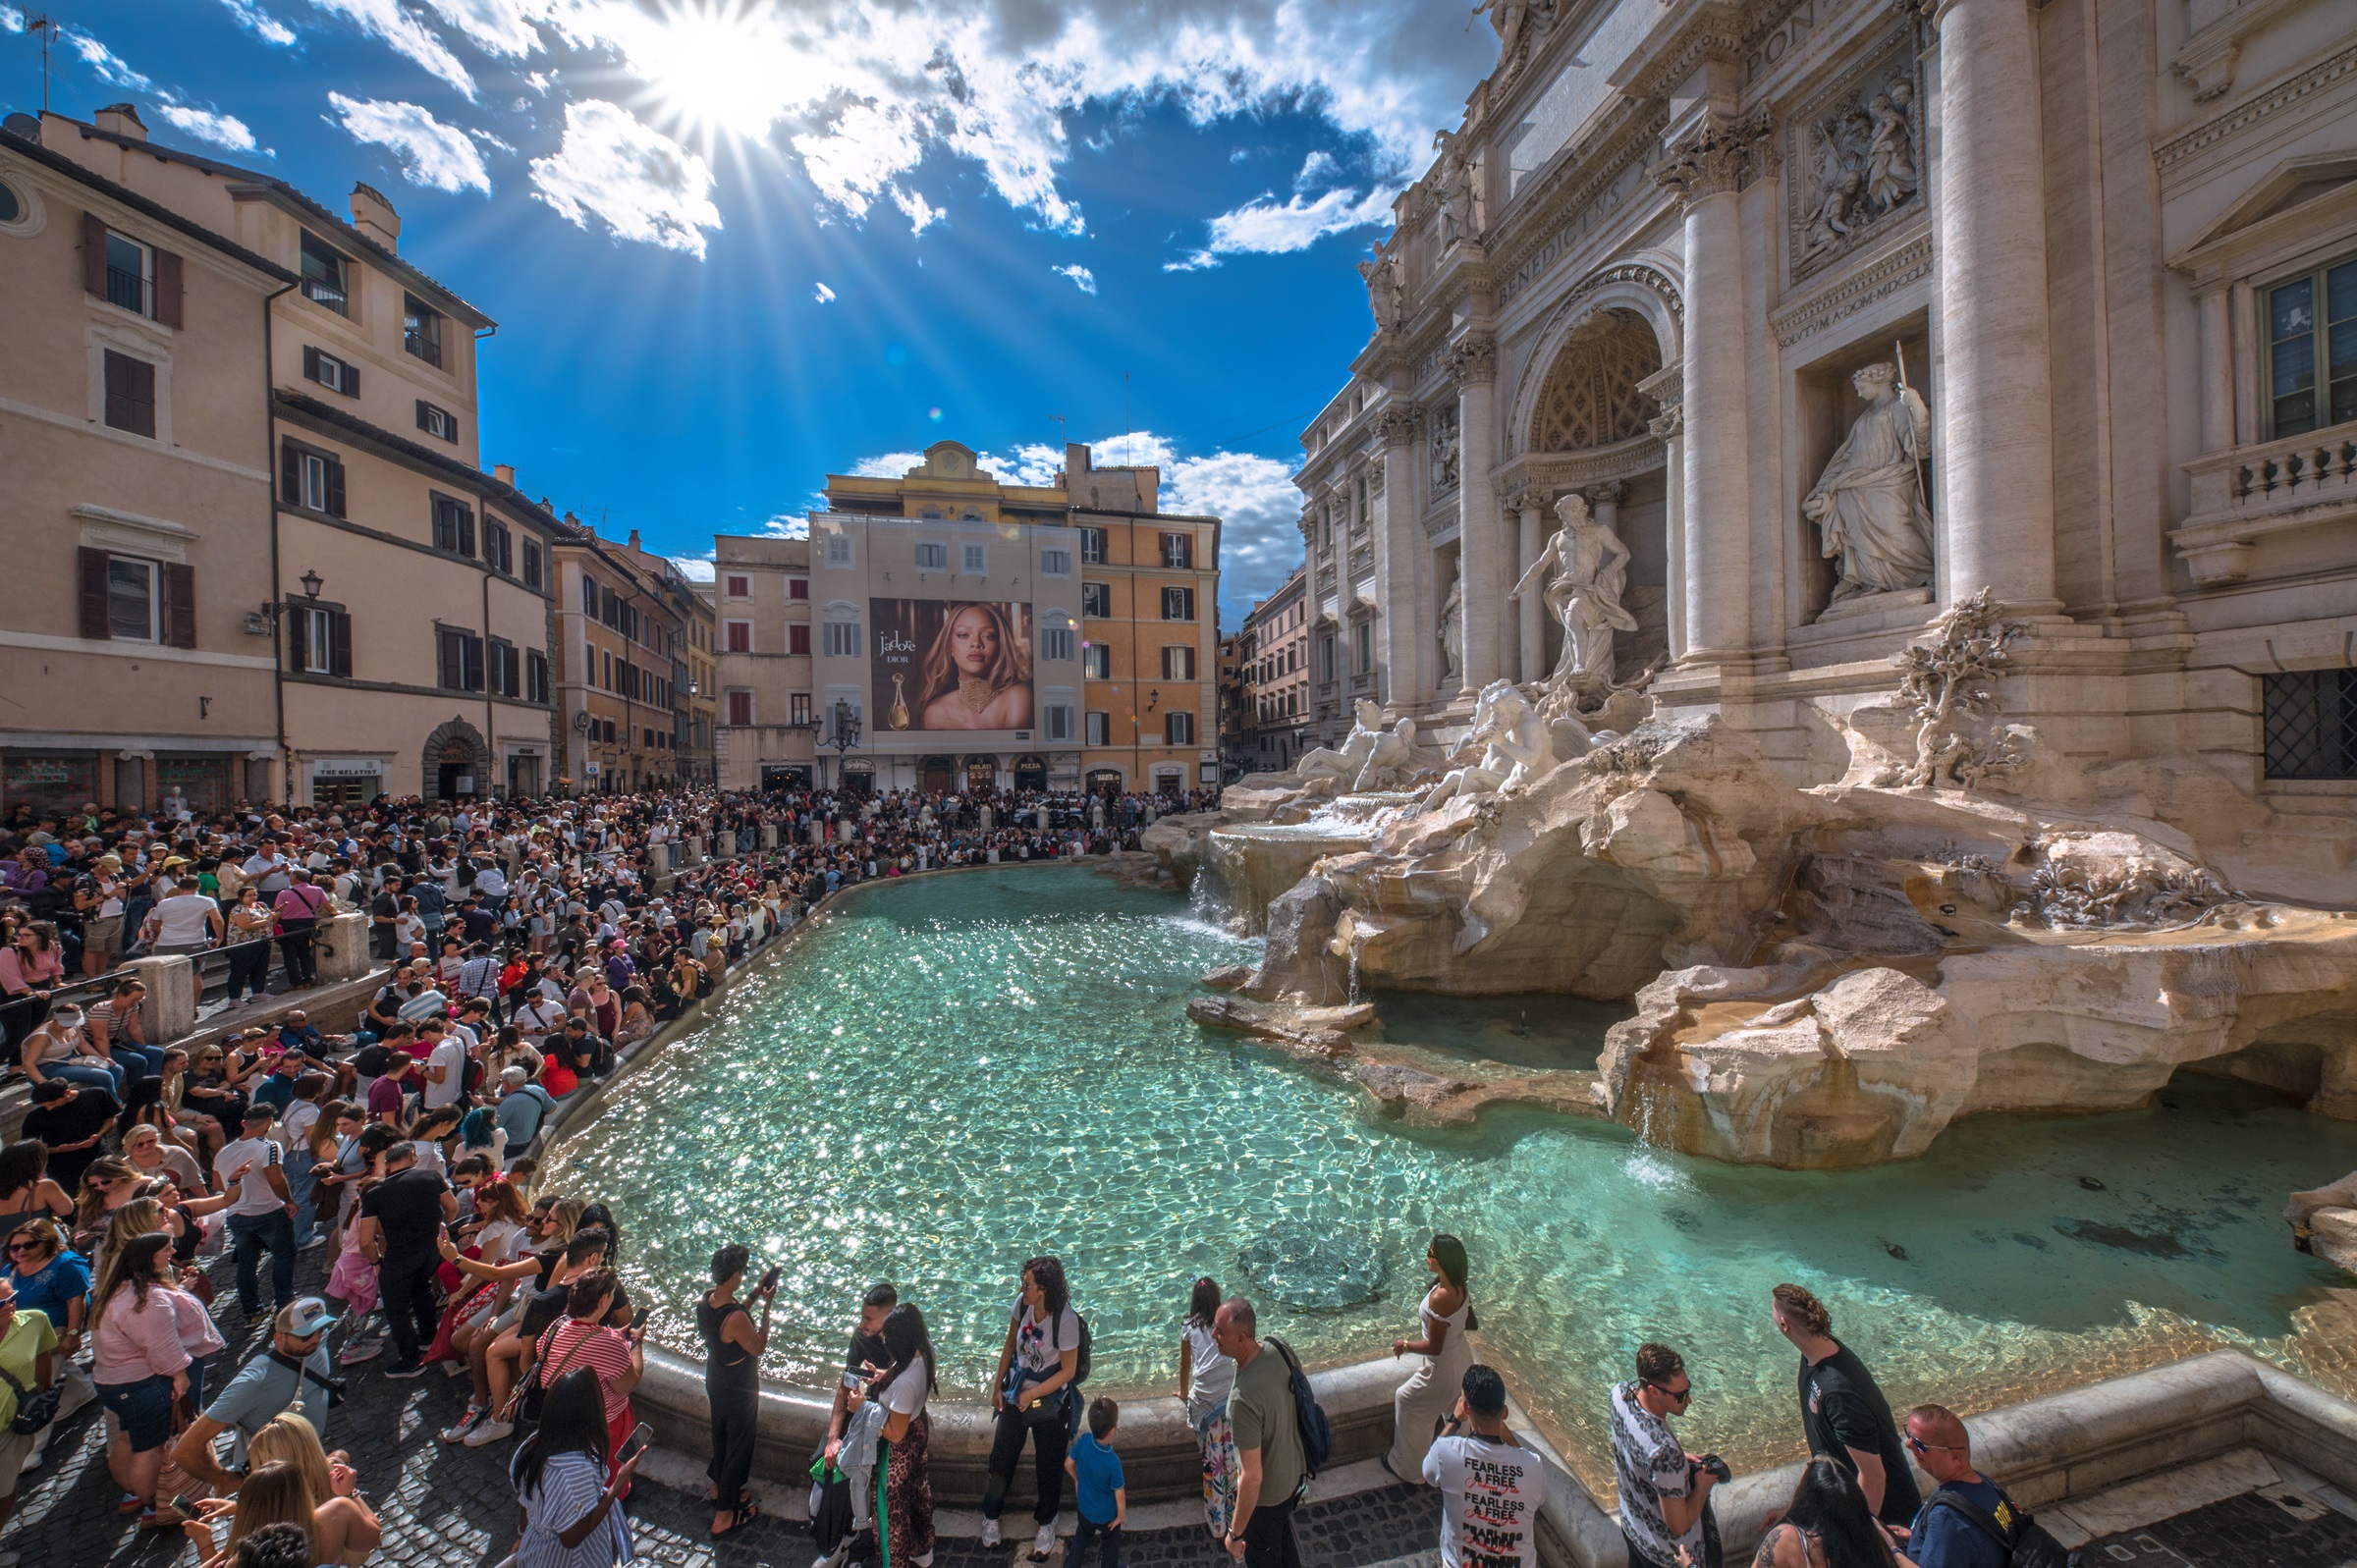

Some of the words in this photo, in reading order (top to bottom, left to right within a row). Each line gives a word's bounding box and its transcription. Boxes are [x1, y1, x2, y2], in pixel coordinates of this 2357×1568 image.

[1499, 182, 1620, 308] BENEDICTVS
[1779, 316, 1830, 351] SOLVTVM
[879, 629, 916, 657] j'adore
[1464, 1457, 1523, 1478] FEARLESS
[1473, 1471, 1482, 1484] &
[1485, 1474, 1516, 1488] FREE
[1464, 1491, 1524, 1511] FEARLESS
[1485, 1507, 1515, 1521] FREE
